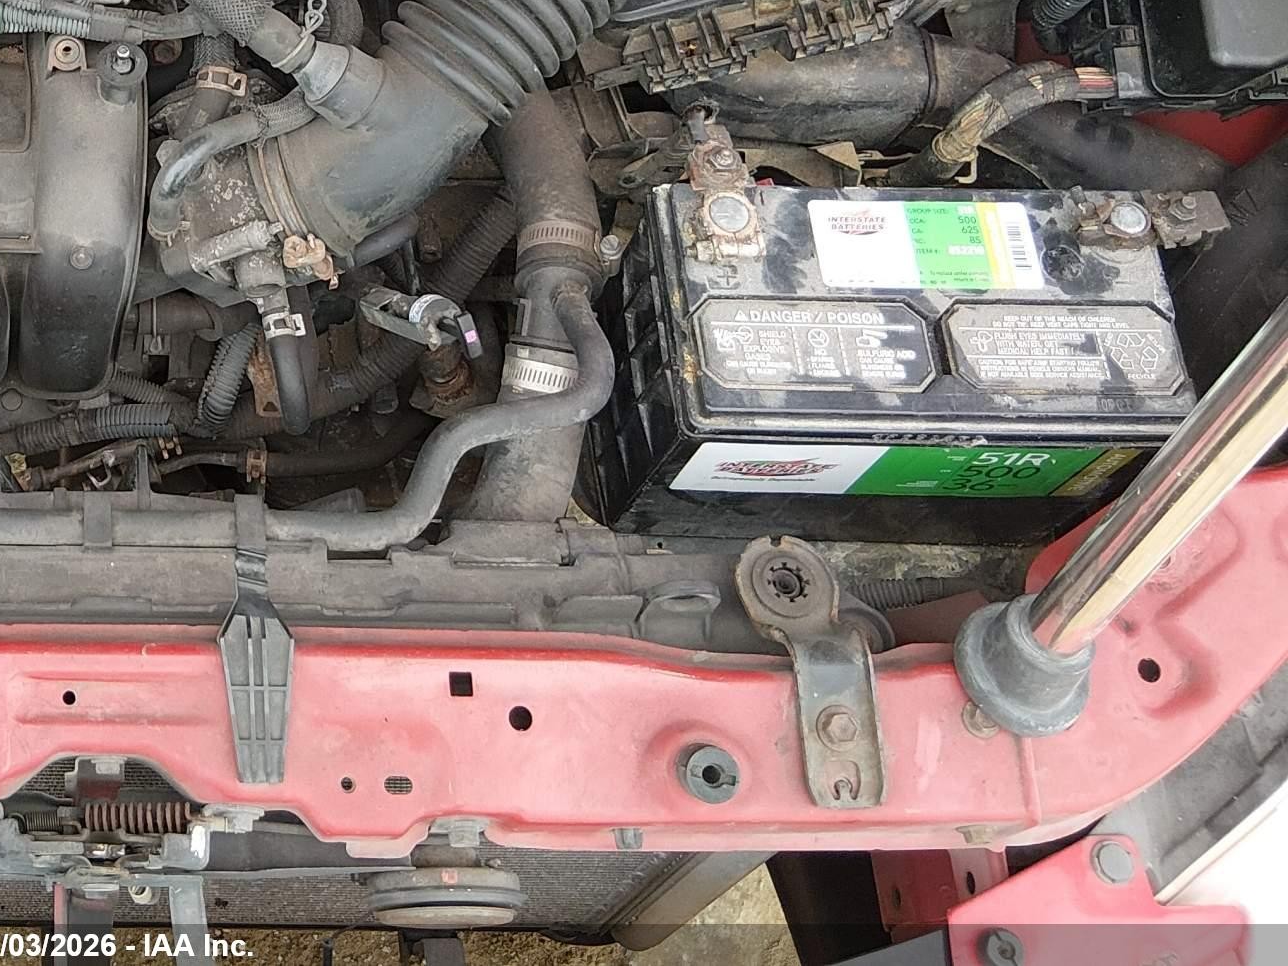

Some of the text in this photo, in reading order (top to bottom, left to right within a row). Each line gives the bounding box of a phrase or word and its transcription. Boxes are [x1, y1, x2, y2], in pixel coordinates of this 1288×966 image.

[958, 216, 976, 224] 500
[961, 226, 979, 234] 625
[969, 236, 981, 244] 85
[750, 310, 811, 323] DANGER
[828, 312, 883, 324] POISON
[759, 330, 787, 338] SHIELD
[744, 345, 786, 354] EXPLOSIVE
[972, 452, 1051, 466] 51R
[956, 466, 1041, 479] 500
